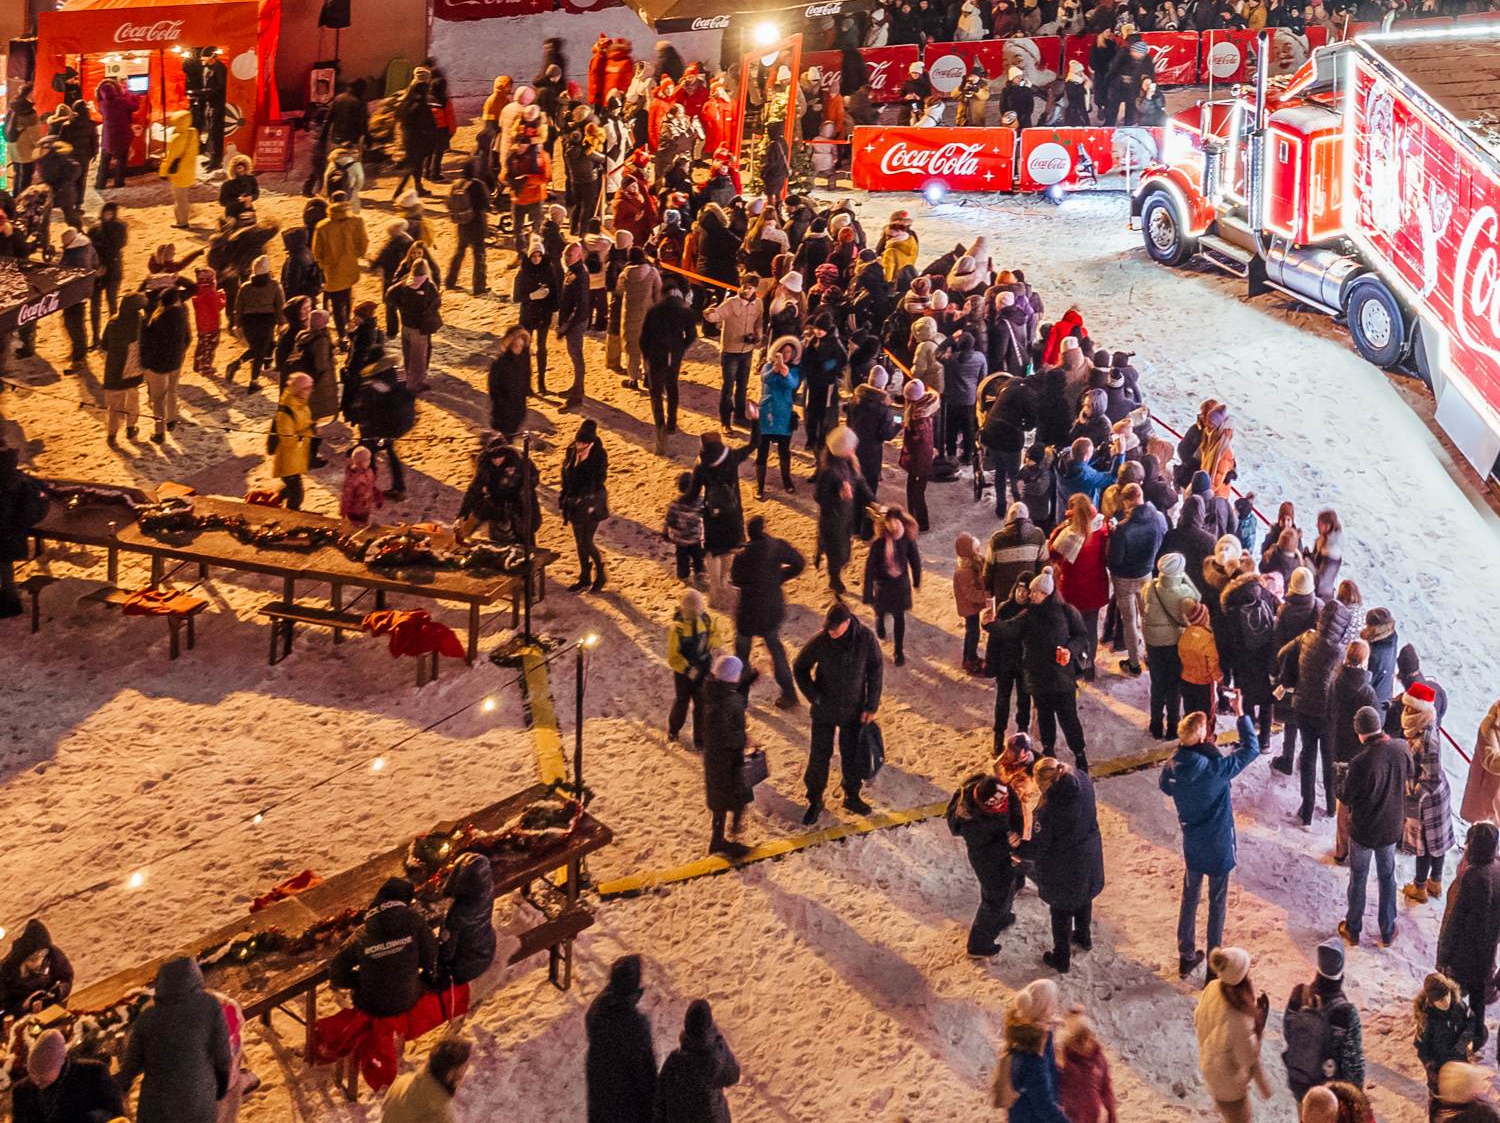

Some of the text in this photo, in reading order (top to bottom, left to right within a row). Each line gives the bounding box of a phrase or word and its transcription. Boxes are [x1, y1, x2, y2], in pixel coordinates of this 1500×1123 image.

[805, 2, 842, 18] Coca-Cola
[691, 15, 731, 31] Coca-Cola
[113, 20, 186, 44] Coca-Cola
[880, 142, 986, 176] Coca-Cola
[1029, 157, 1067, 171] Coca-Cola
